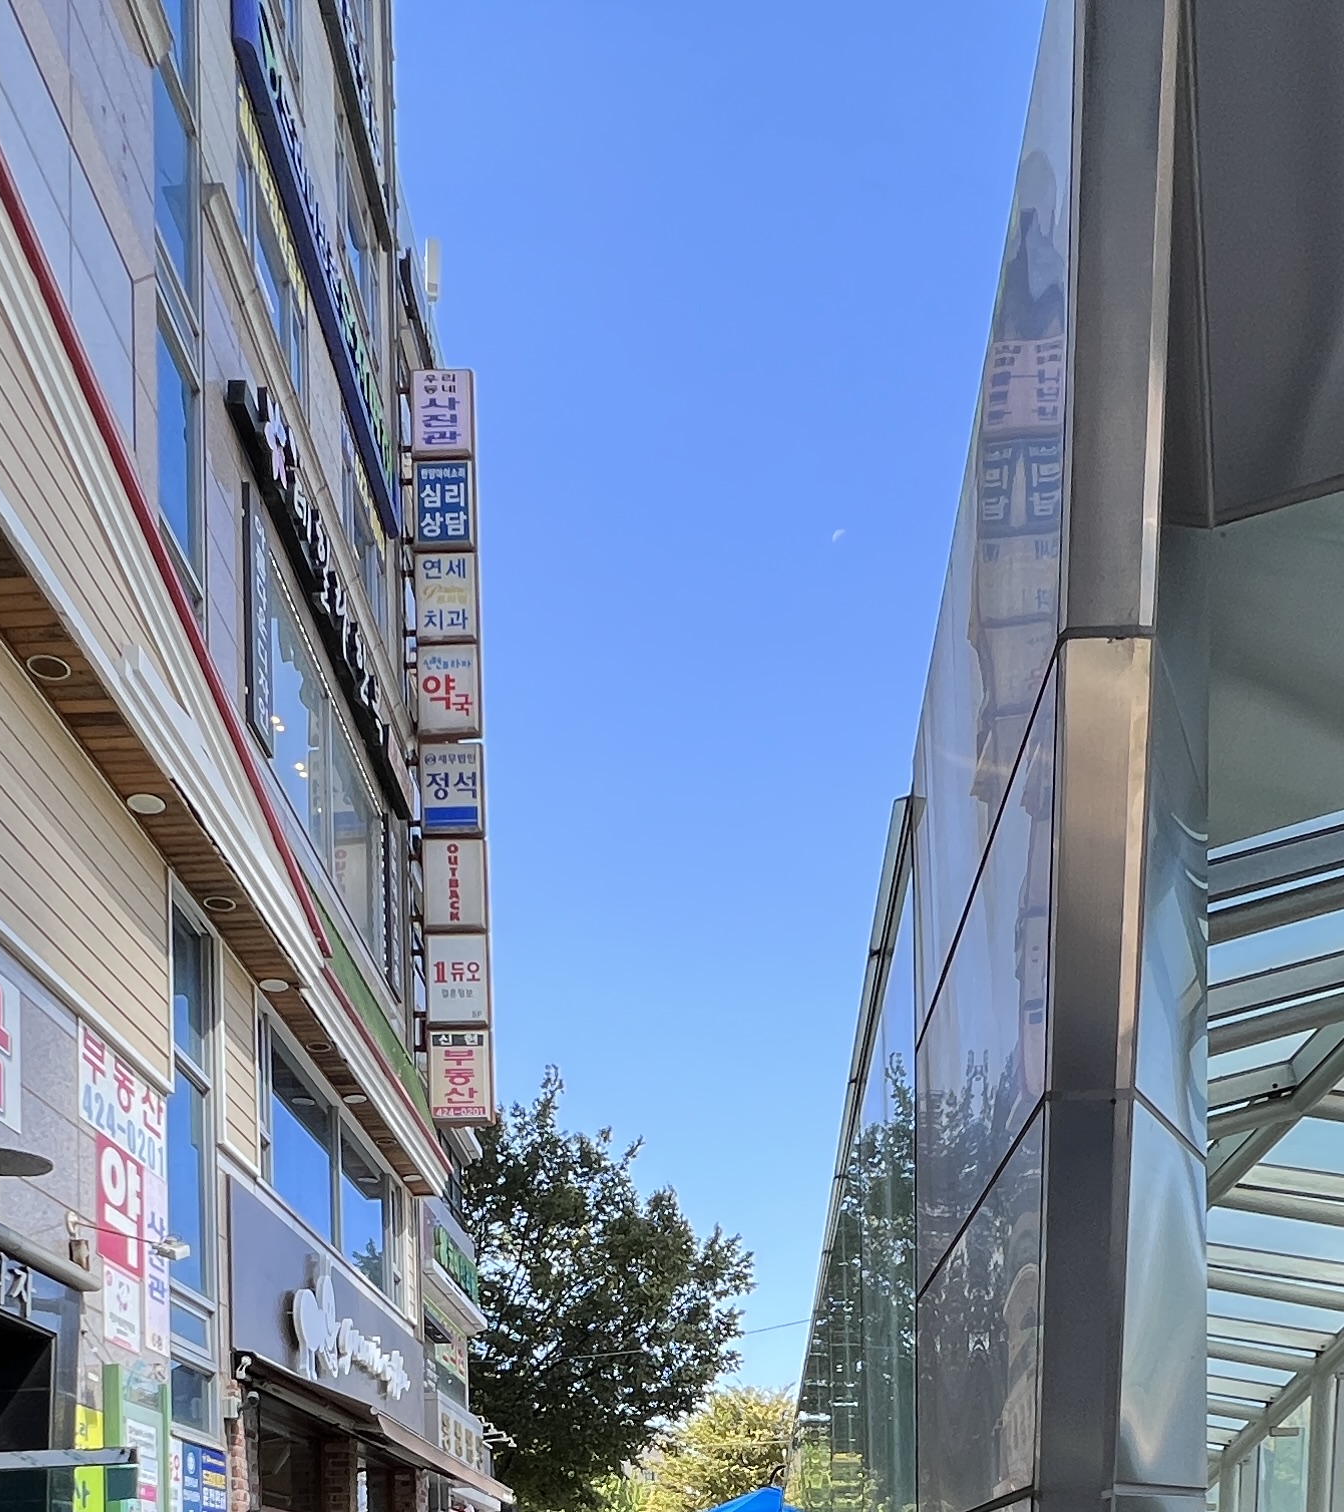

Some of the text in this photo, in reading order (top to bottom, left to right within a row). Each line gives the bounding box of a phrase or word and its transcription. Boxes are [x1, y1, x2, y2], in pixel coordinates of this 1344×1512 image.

[420, 396, 462, 445] 사진관
[420, 482, 465, 508] 심리
[420, 511, 467, 537] 상담
[422, 558, 466, 580] 연세
[423, 608, 469, 631] 치과
[422, 673, 473, 717] 약국
[425, 771, 477, 801] 정석
[446, 843, 461, 922] OUTBACK
[82, 1025, 164, 1140] 부동산
[443, 1049, 478, 1104] 부동산
[82, 1083, 164, 1178] 424-0201
[436, 1107, 484, 1117] 424-0201
[100, 1146, 143, 1270] 약
